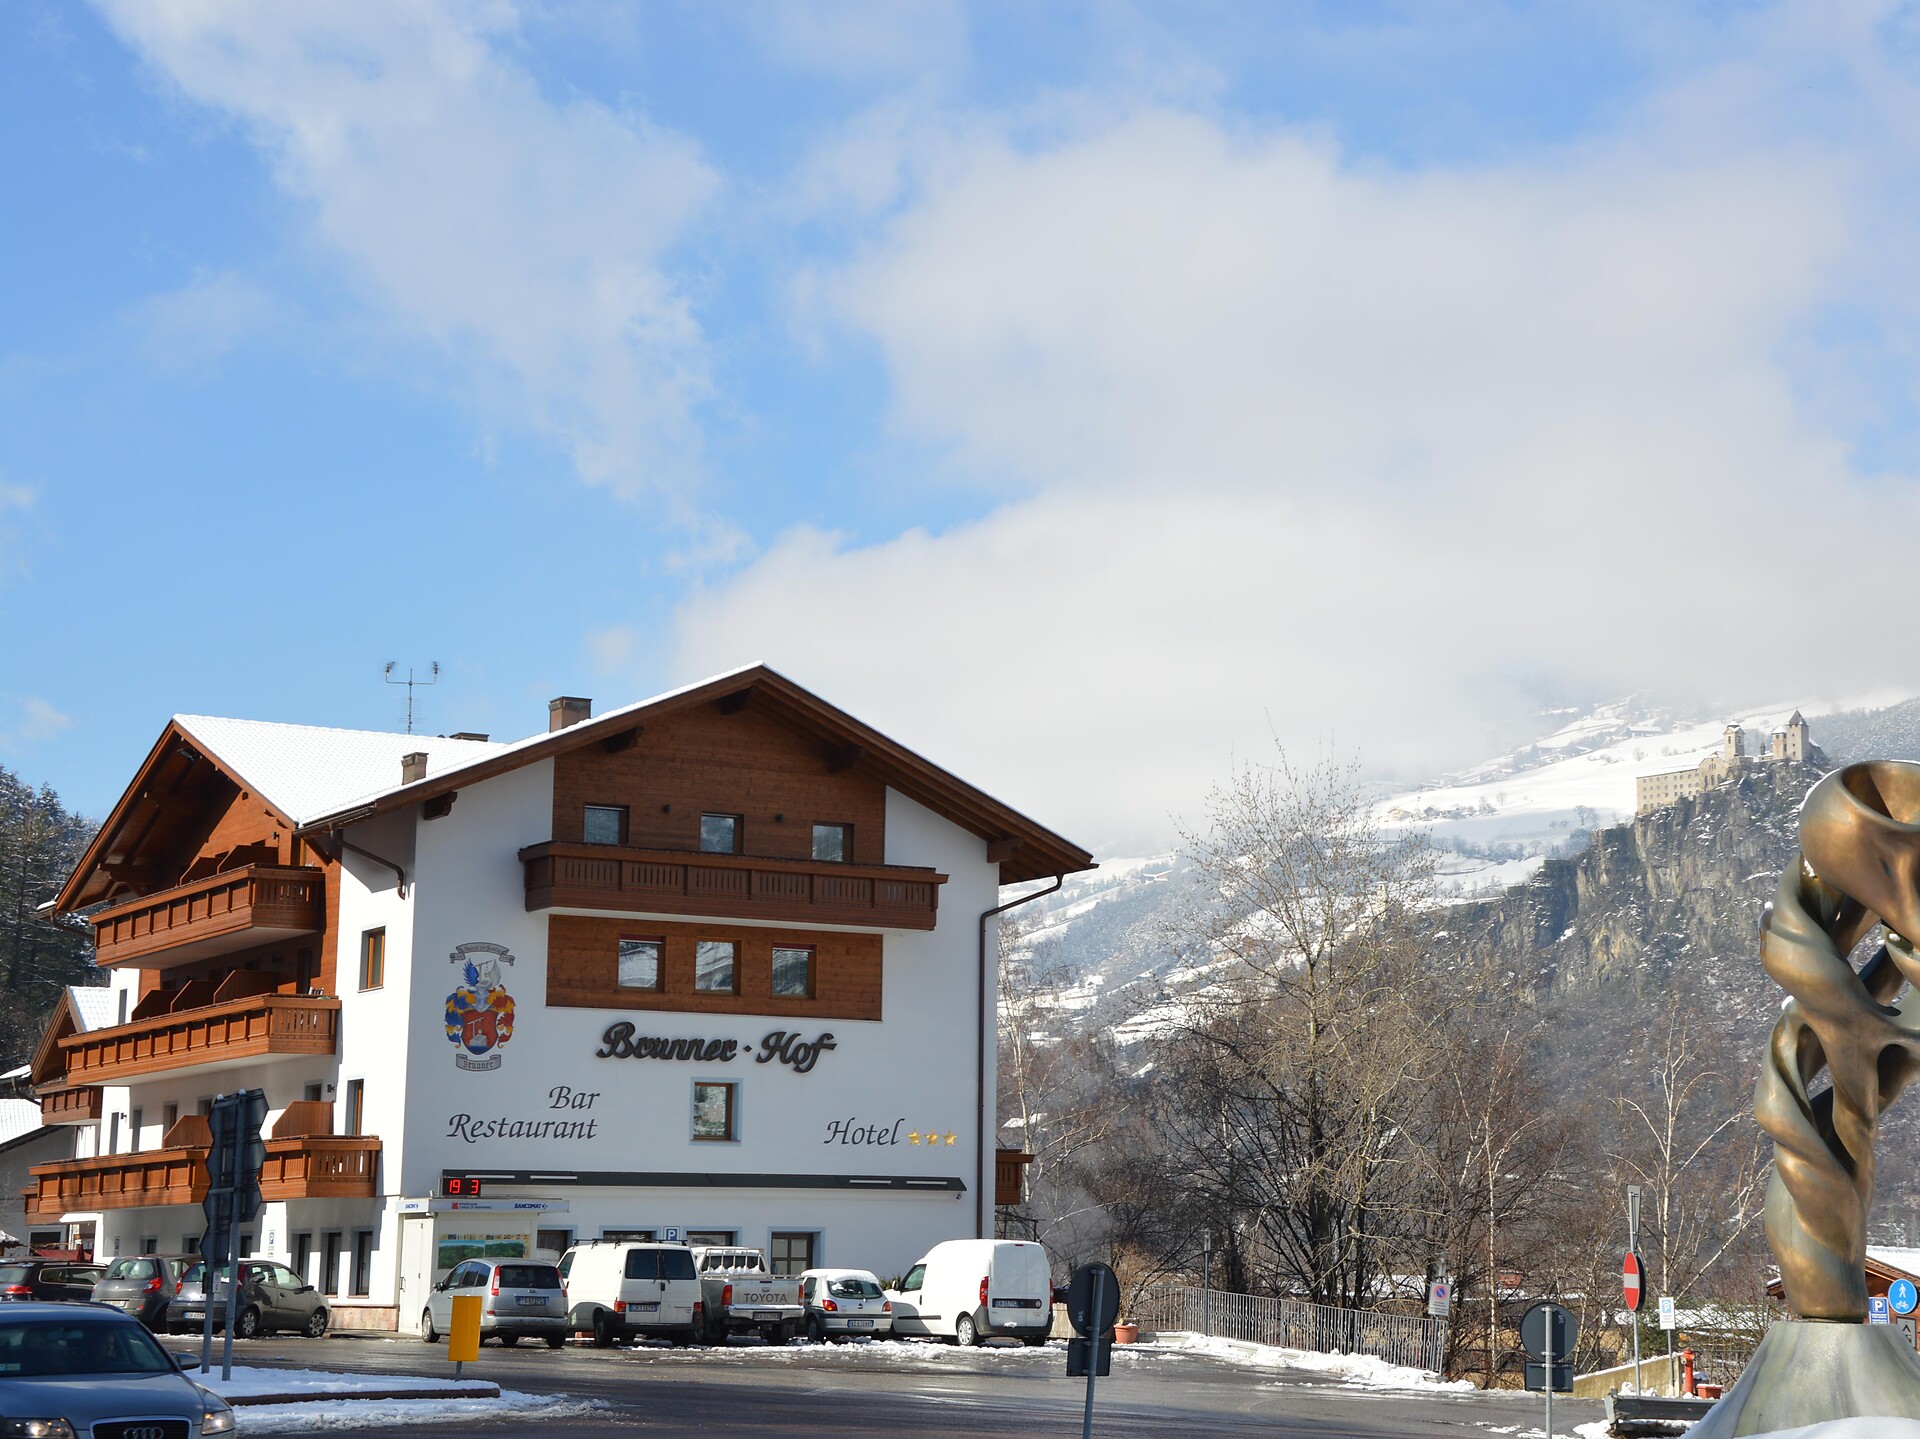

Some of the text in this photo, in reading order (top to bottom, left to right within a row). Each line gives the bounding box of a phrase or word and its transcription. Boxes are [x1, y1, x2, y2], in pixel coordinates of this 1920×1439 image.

[596, 1021, 838, 1073] Brunner Hof
[549, 1085, 600, 1109] Bar
[446, 1113, 598, 1143] Restaurant
[823, 1117, 905, 1145] Hotel
[449, 1179, 479, 1194] 19 3
[744, 1293, 787, 1302] TOYOTA
[1874, 1300, 1883, 1312] P
